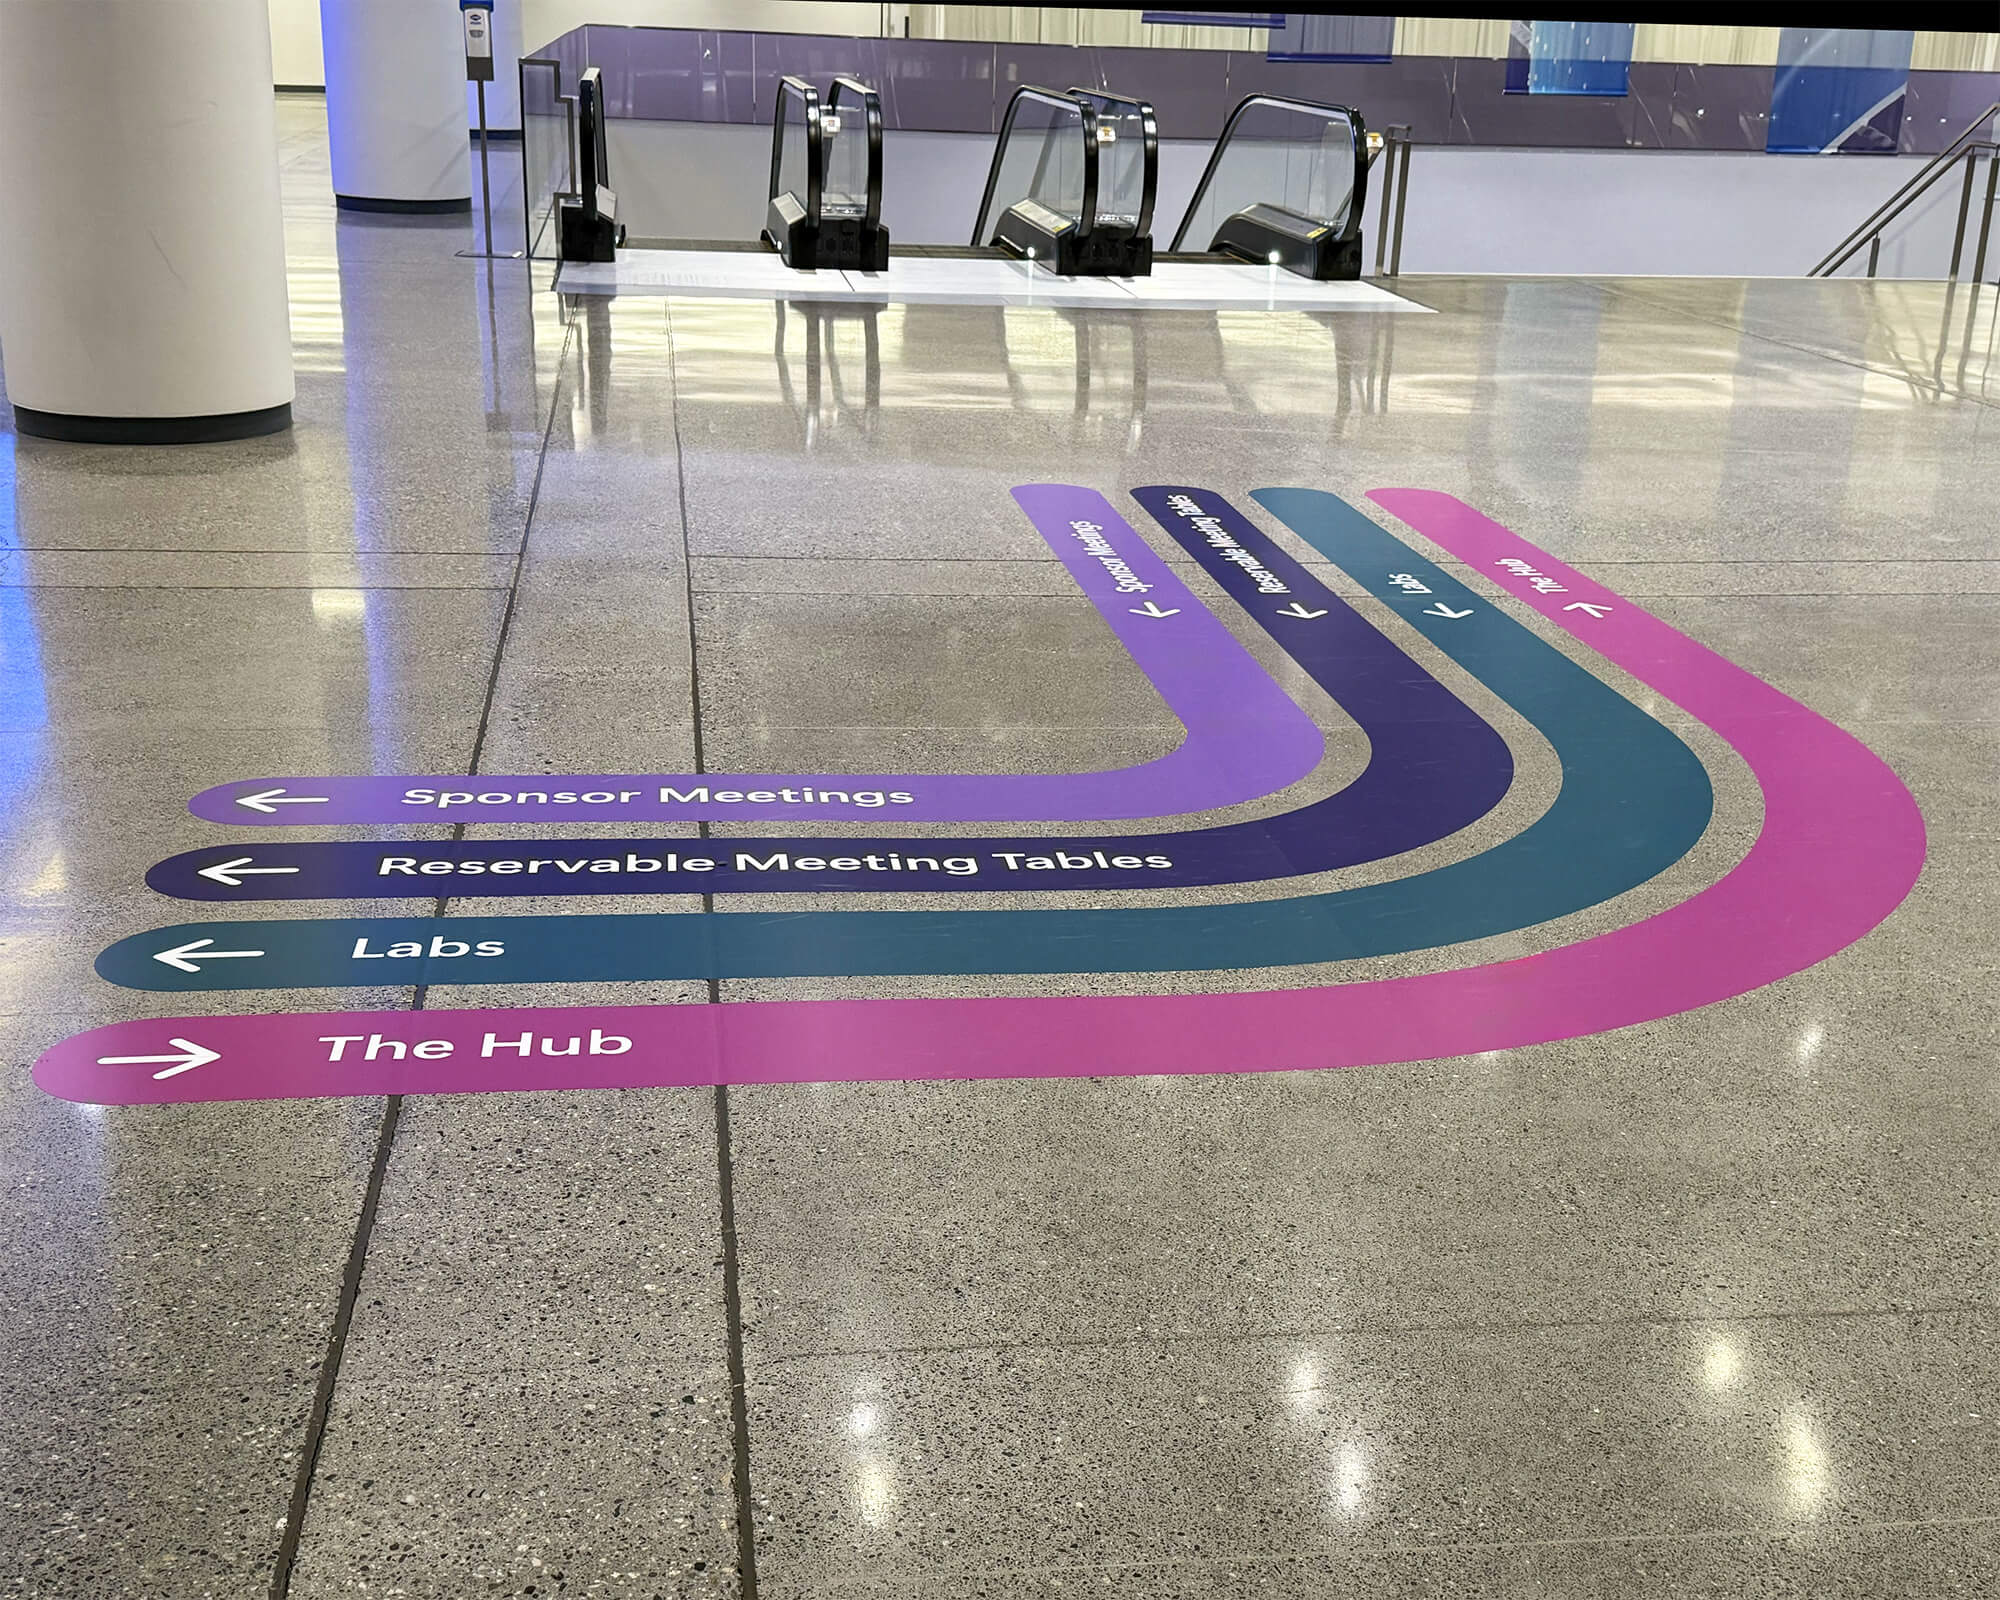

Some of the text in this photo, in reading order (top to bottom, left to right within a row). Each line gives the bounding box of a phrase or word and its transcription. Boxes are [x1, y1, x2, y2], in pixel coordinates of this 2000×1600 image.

[1068, 520, 1154, 593] Sponsor Meetings
[1166, 494, 1292, 594] Reservable Meeting Tables
[1388, 573, 1433, 594] Labs
[1494, 557, 1569, 595] The Hub
[400, 787, 915, 809] Sponsor Meetings
[378, 850, 1174, 876] Reservable Meeting Tables
[350, 935, 507, 960] Labs
[317, 1028, 634, 1063] The Hub
